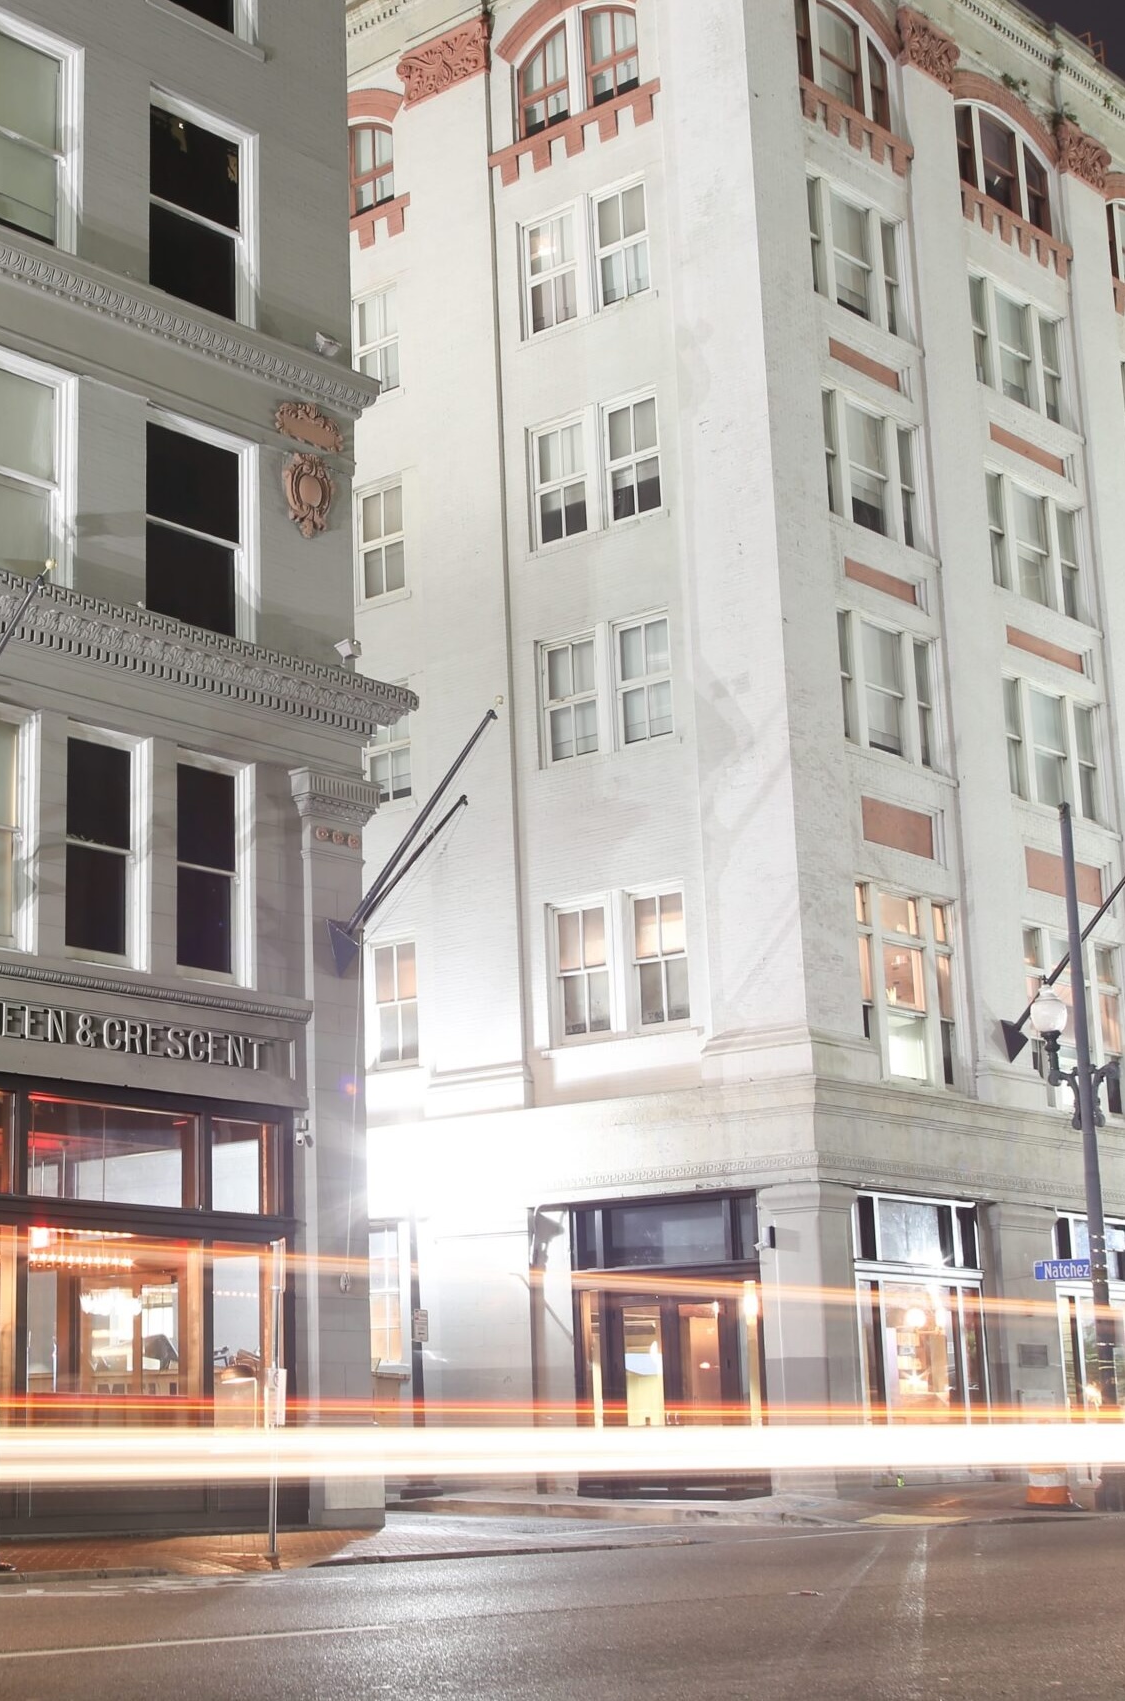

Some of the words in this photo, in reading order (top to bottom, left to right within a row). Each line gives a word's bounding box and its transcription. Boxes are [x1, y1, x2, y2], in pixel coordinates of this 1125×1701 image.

[76, 1013, 97, 1048] &
[103, 1017, 267, 1070] CRESCENT
[1044, 1262, 1090, 1278] Natchez
